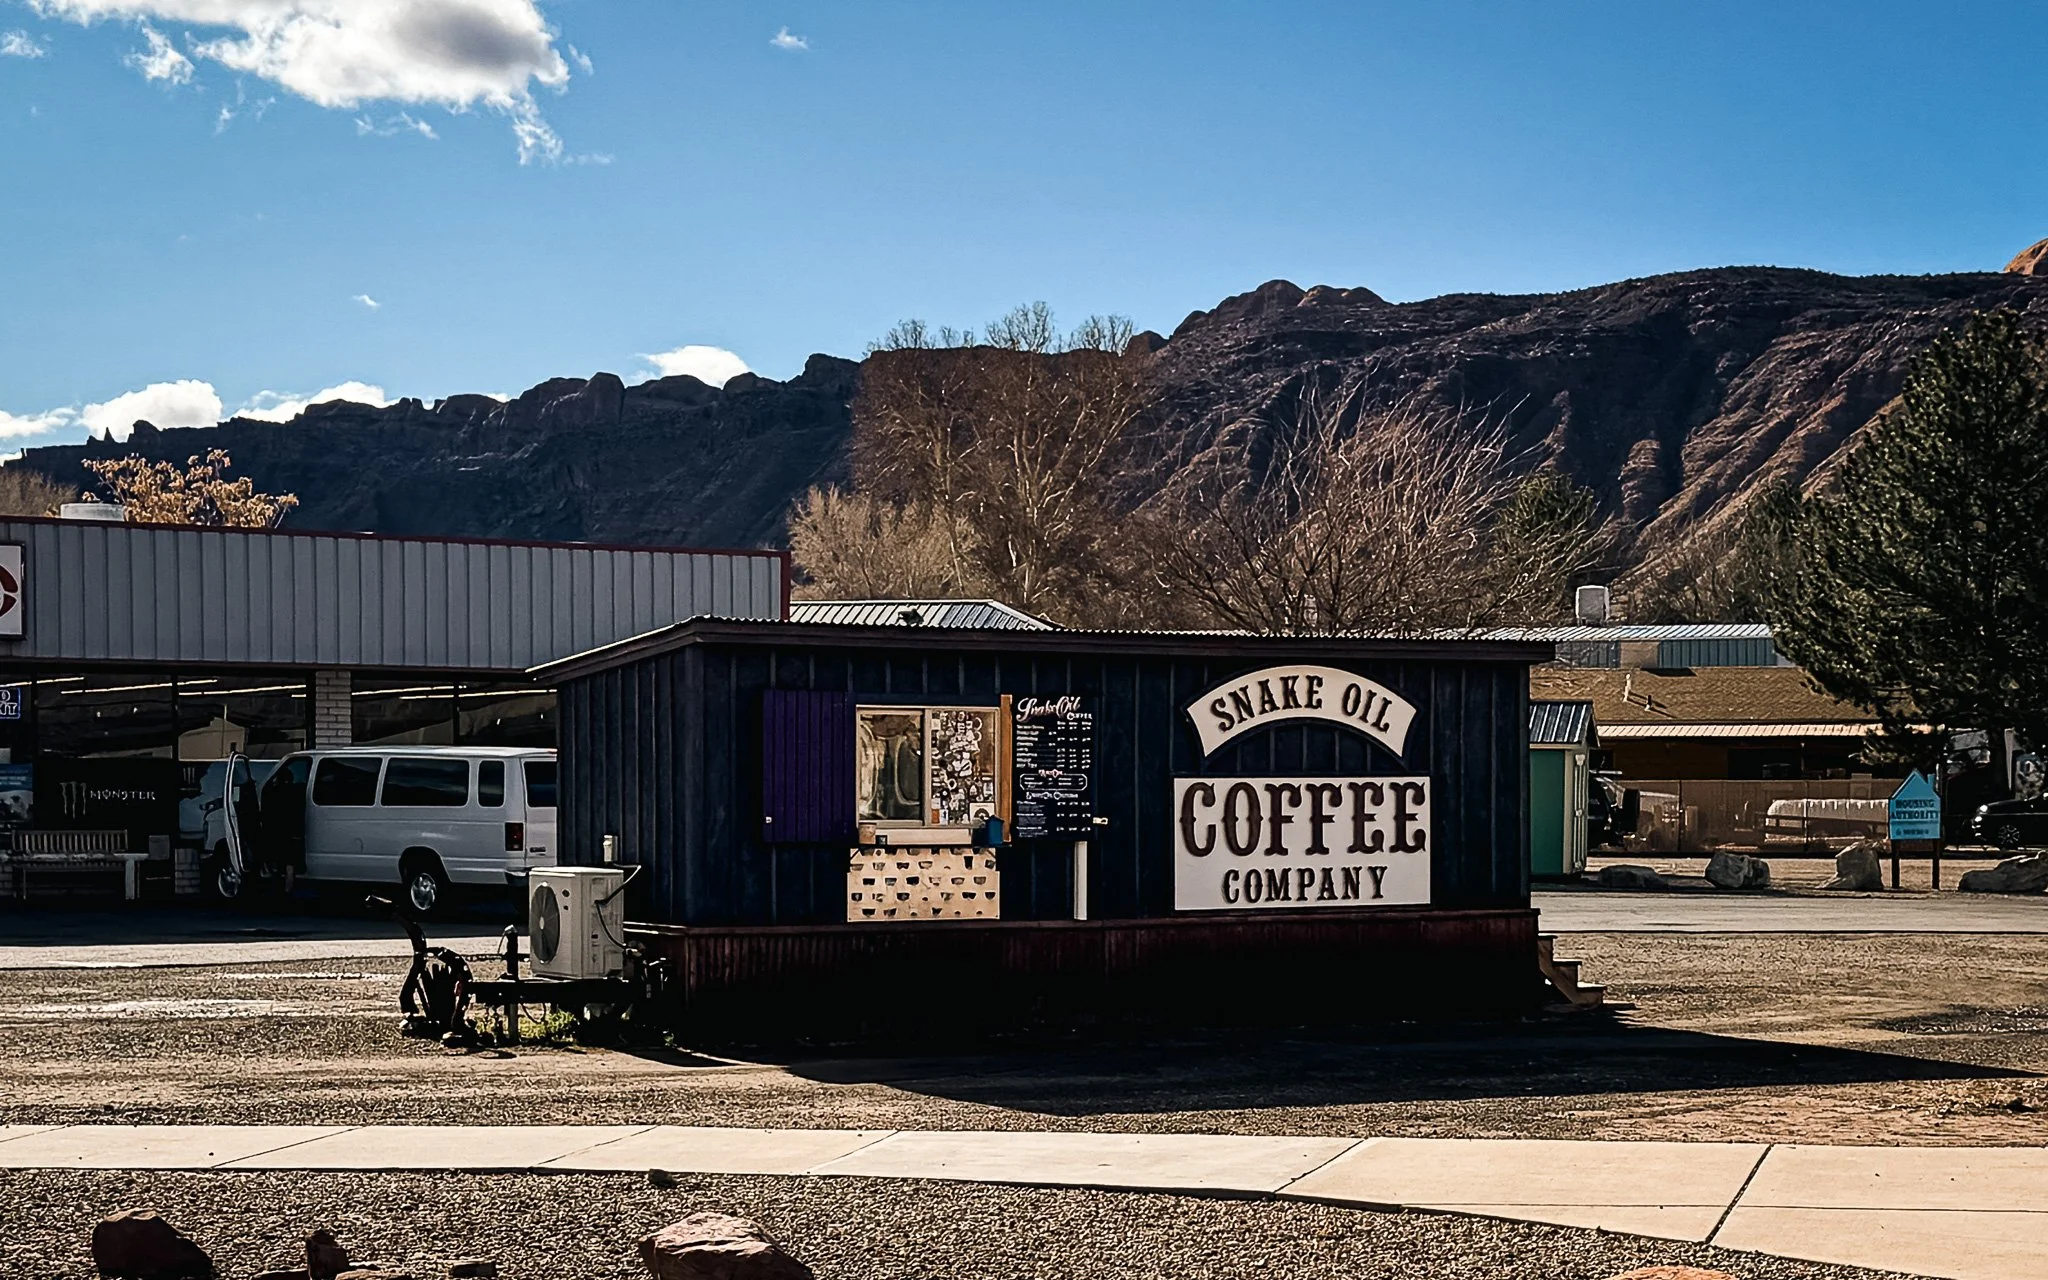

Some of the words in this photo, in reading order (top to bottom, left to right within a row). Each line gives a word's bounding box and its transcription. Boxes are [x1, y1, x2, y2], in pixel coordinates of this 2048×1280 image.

[1210, 675, 1323, 732] SNAKE
[1342, 682, 1393, 733] OIL
[90, 789, 156, 801] MONSTER
[1896, 799, 1935, 808] HOUSING
[1179, 781, 1427, 858] COFFEE
[1891, 810, 1938, 819] AUTHORITY
[1222, 865, 1388, 904] COMPANY
